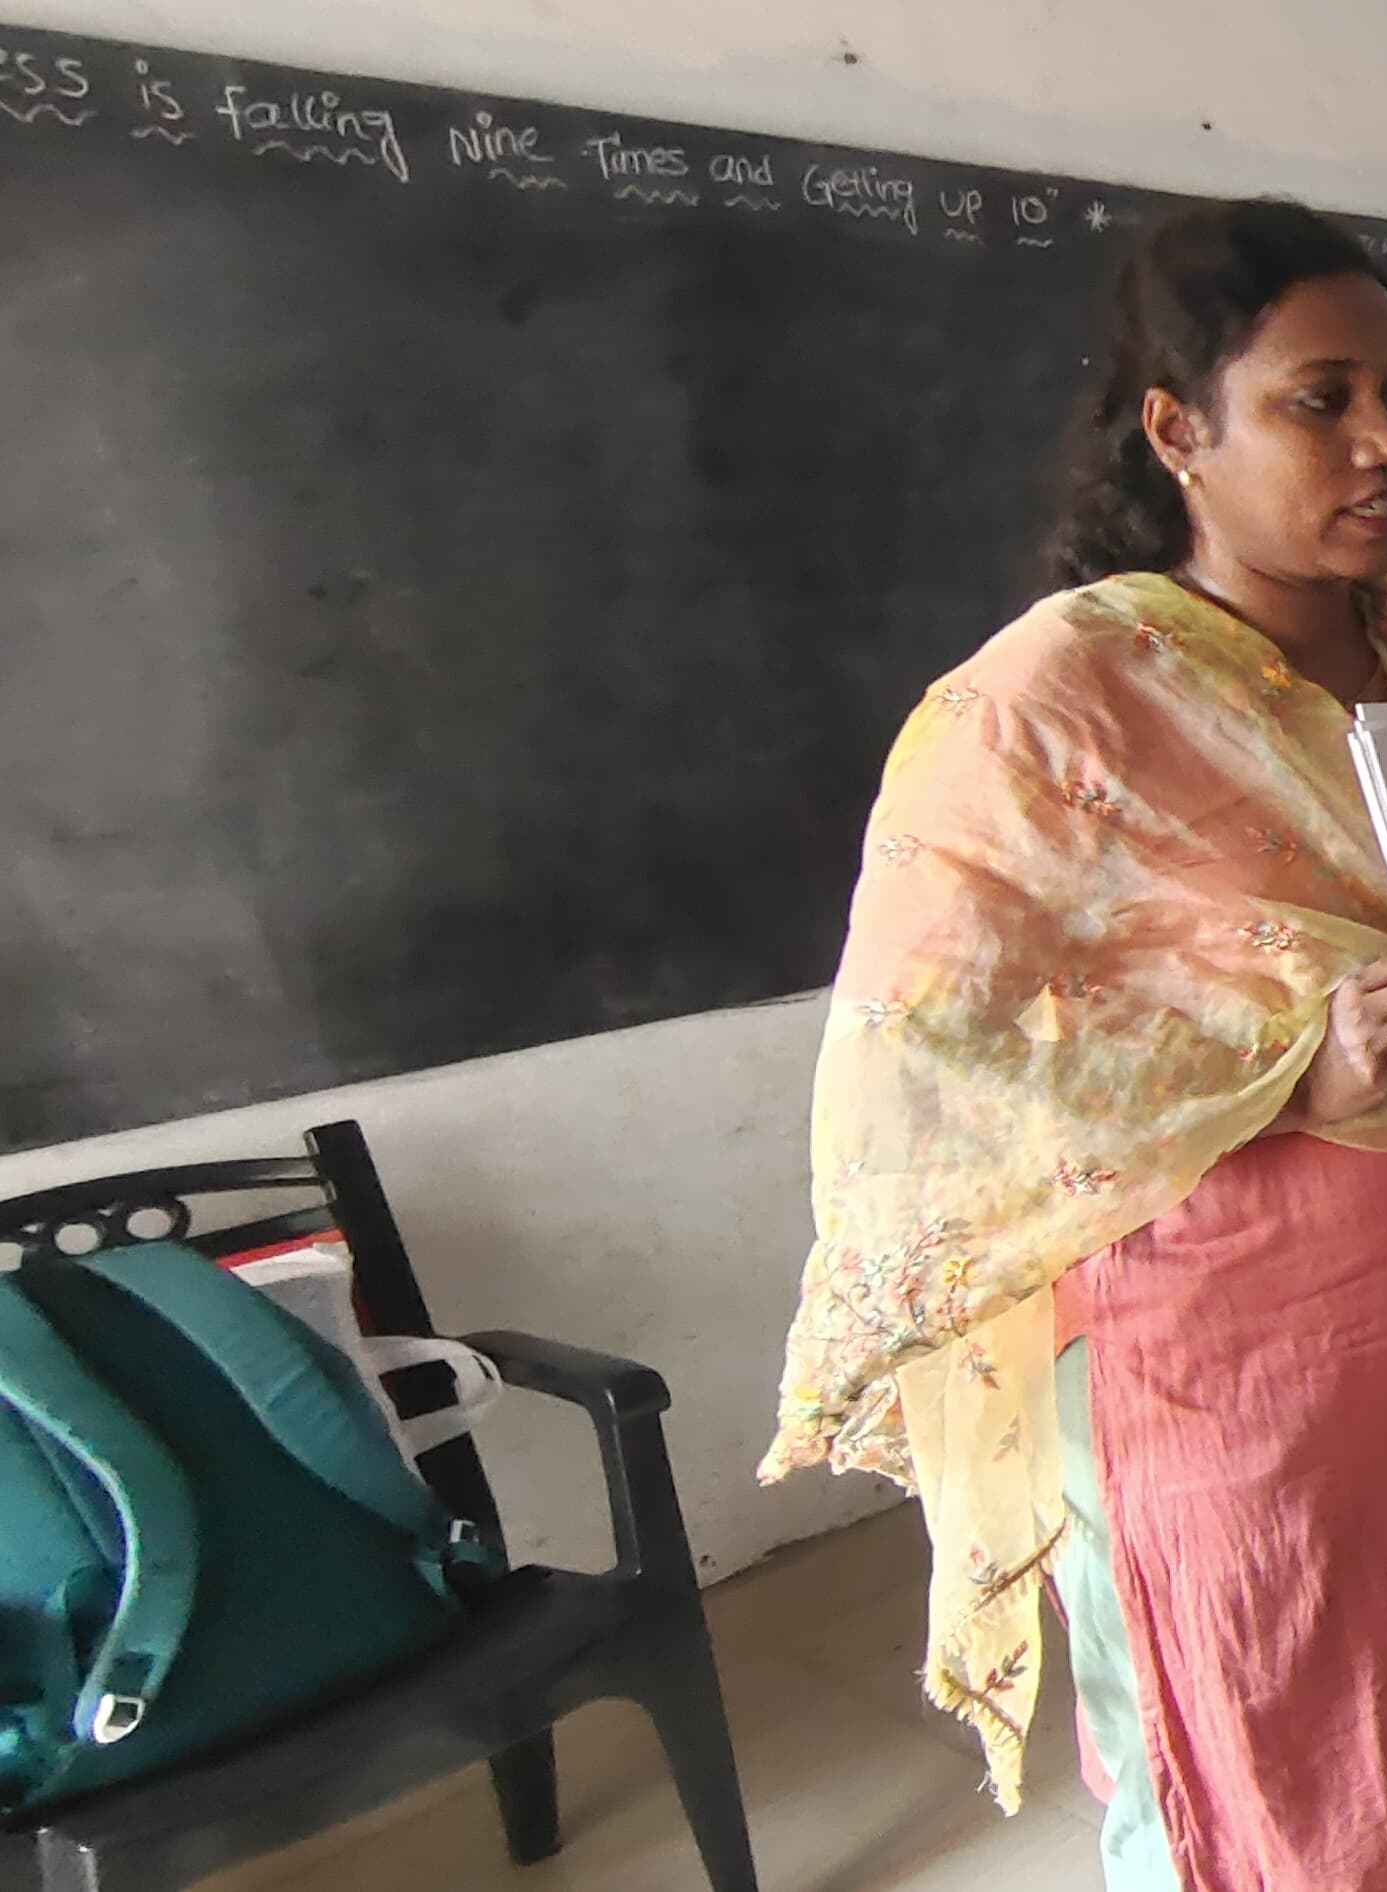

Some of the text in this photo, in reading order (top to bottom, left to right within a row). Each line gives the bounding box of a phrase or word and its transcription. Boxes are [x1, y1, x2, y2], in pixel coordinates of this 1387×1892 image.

[133, 58, 184, 120] is
[214, 86, 410, 183] falling
[450, 111, 554, 166] Nine
[584, 131, 690, 180] Times
[709, 154, 774, 186] and
[801, 164, 918, 236] Getting
